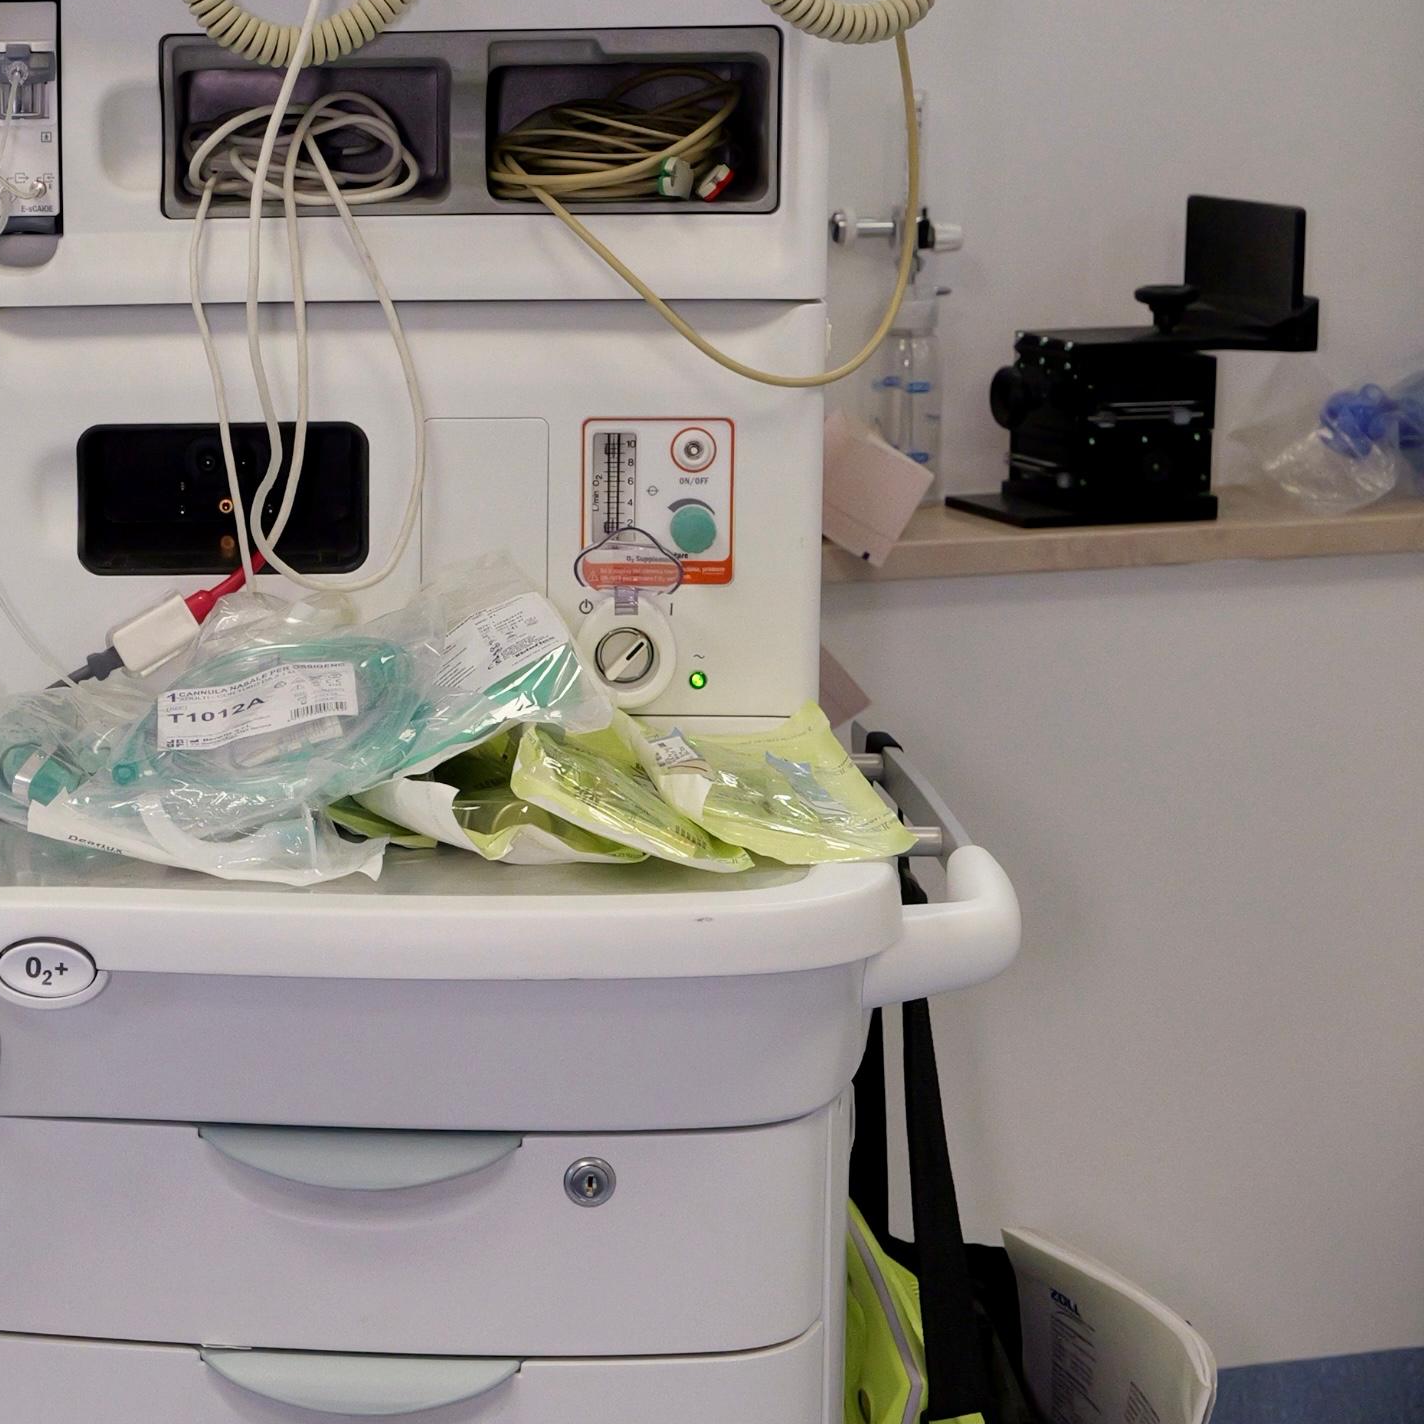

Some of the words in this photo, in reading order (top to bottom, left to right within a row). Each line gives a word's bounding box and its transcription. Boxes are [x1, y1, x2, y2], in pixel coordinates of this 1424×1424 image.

[626, 440, 636, 448] 10
[627, 458, 634, 467] 8
[627, 477, 634, 485] 6
[679, 477, 709, 486] ON/OFF
[626, 519, 634, 527] 2
[167, 693, 176, 703] 1
[178, 687, 228, 698] CANNULA
[229, 674, 267, 692] NASALE
[167, 697, 265, 724] T1012A
